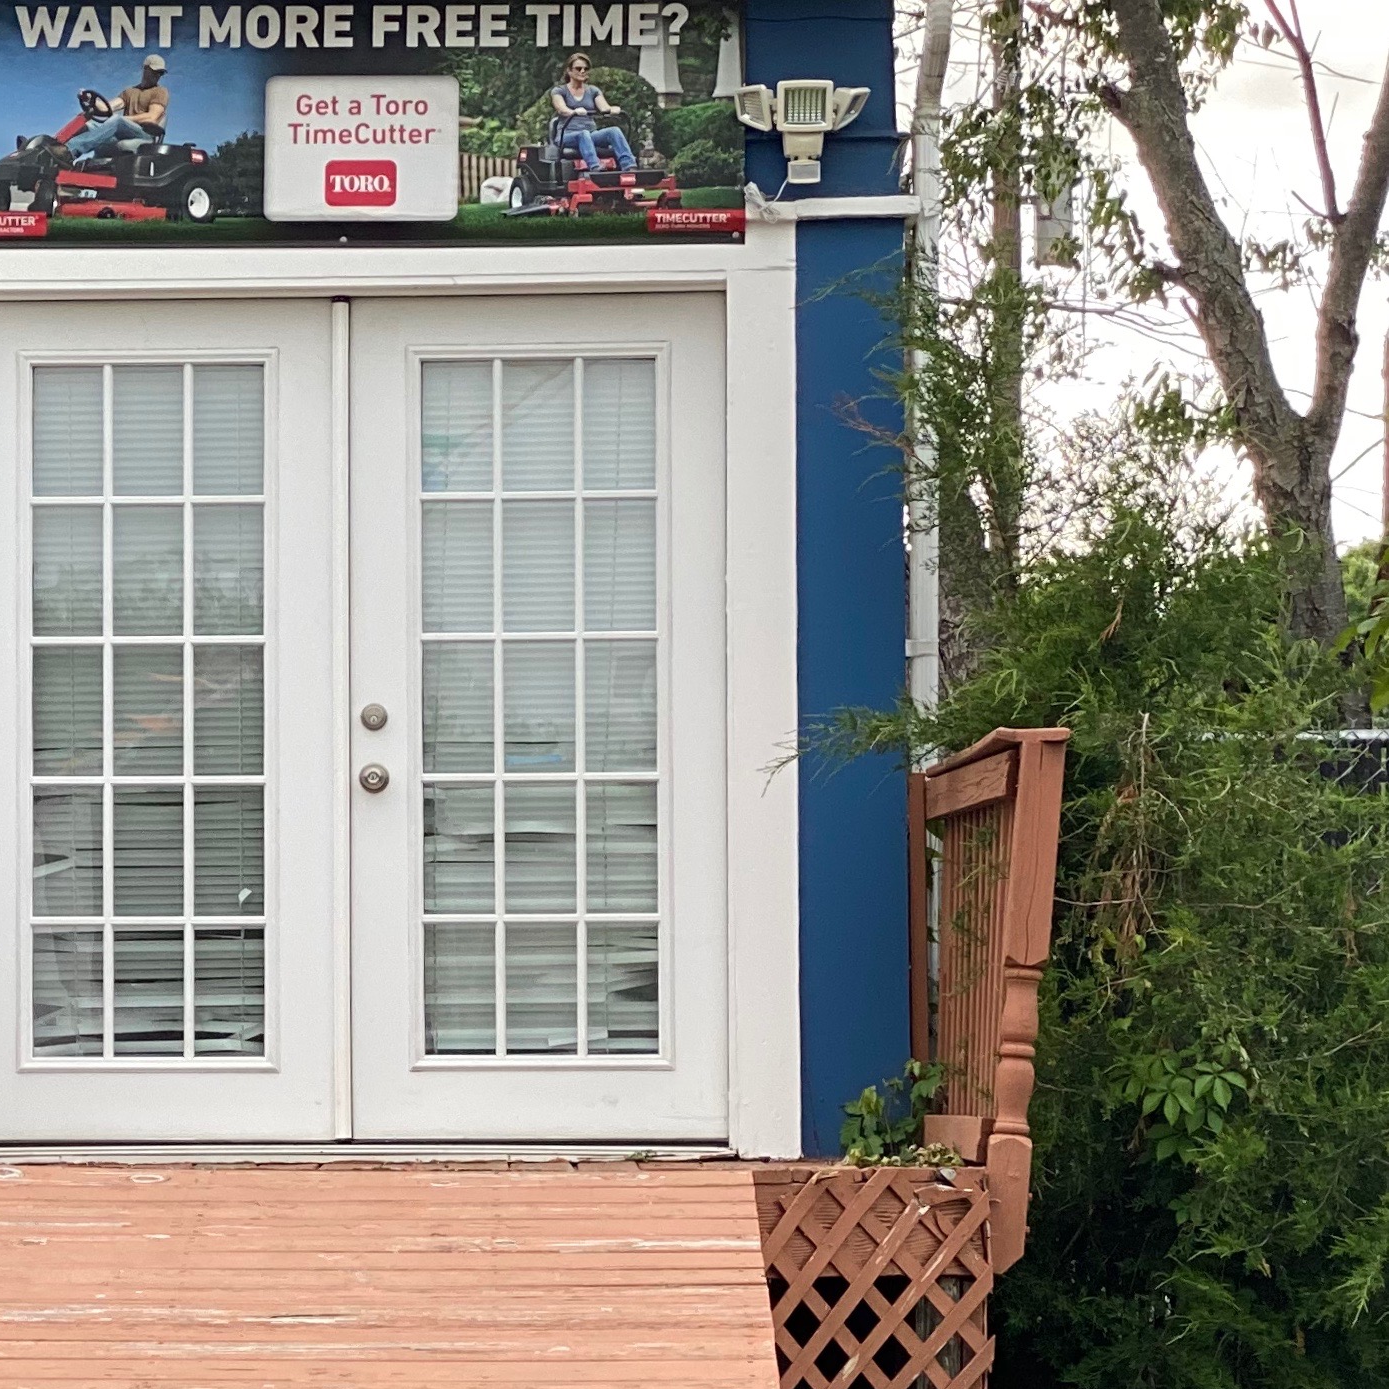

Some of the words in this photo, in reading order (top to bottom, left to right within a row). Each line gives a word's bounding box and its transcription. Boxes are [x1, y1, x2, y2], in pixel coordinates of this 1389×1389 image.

[15, 5, 183, 49] WANT
[199, 4, 354, 48] MORE
[372, 4, 510, 48] FREE
[525, 2, 689, 47] TIME?
[296, 94, 339, 116] Get
[348, 99, 361, 116] a
[370, 94, 428, 116] Toro
[288, 122, 437, 145] TimeCutter
[329, 174, 390, 193] TORO
[654, 213, 728, 223] TIMECUTTER
